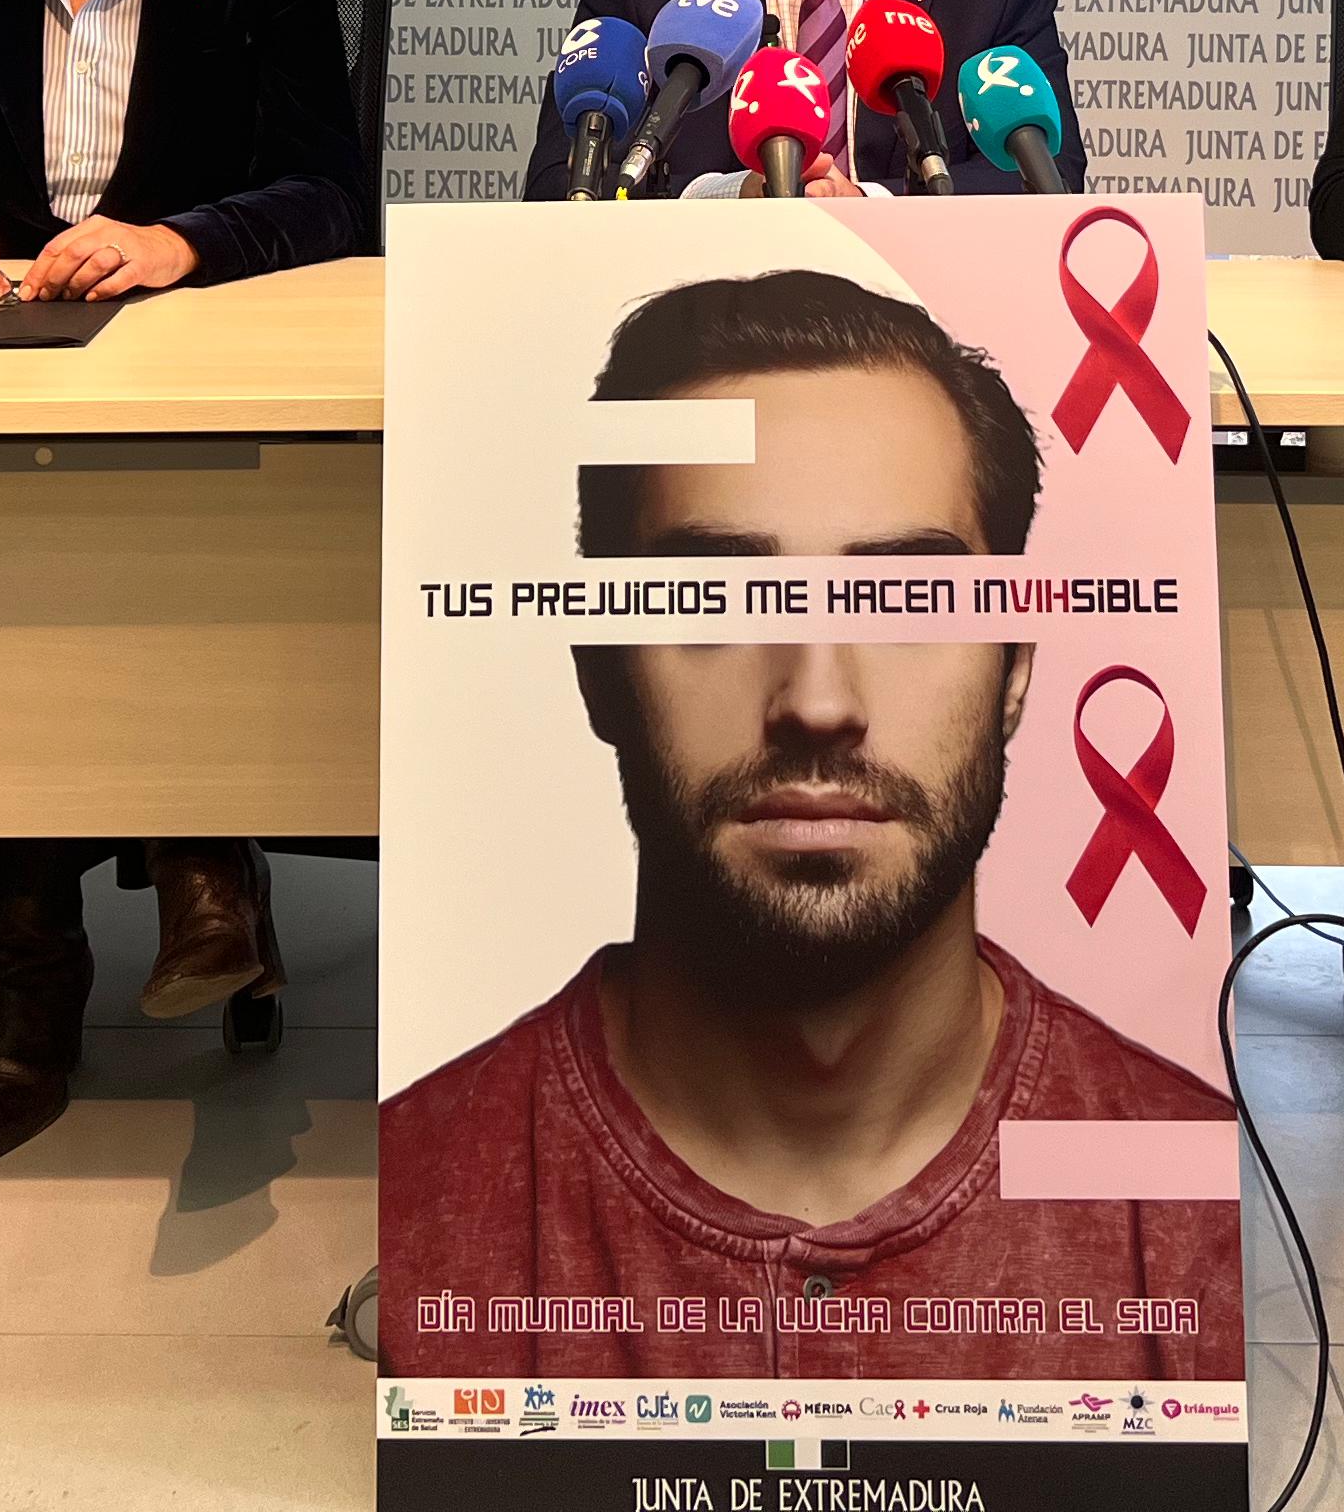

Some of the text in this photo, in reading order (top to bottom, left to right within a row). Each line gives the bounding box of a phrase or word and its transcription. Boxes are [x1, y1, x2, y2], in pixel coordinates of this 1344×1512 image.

[884, 11, 935, 35] rne
[1185, 32, 1307, 70] JUNTA DE
[558, 47, 598, 74] COPE
[420, 583, 492, 617] TUS
[657, 1297, 706, 1332] DE
[719, 1297, 763, 1332] LA
[776, 1297, 891, 1333] LUCHA
[904, 1298, 1046, 1333] CONTRA
[1059, 1299, 1104, 1333] EL
[570, 1394, 626, 1417] imex
[720, 1410, 777, 1419] Victoria Kent
[935, 1403, 988, 1416] Cruz Roja
[1017, 1403, 1063, 1415] Fundación
[1184, 1403, 1239, 1417] triángulo
[392, 1420, 409, 1430] SES
[1071, 1413, 1111, 1421] APRAMP
[1123, 1417, 1154, 1430] MZC
[632, 1478, 987, 1512] JUNTA DE EXTREMADURA
